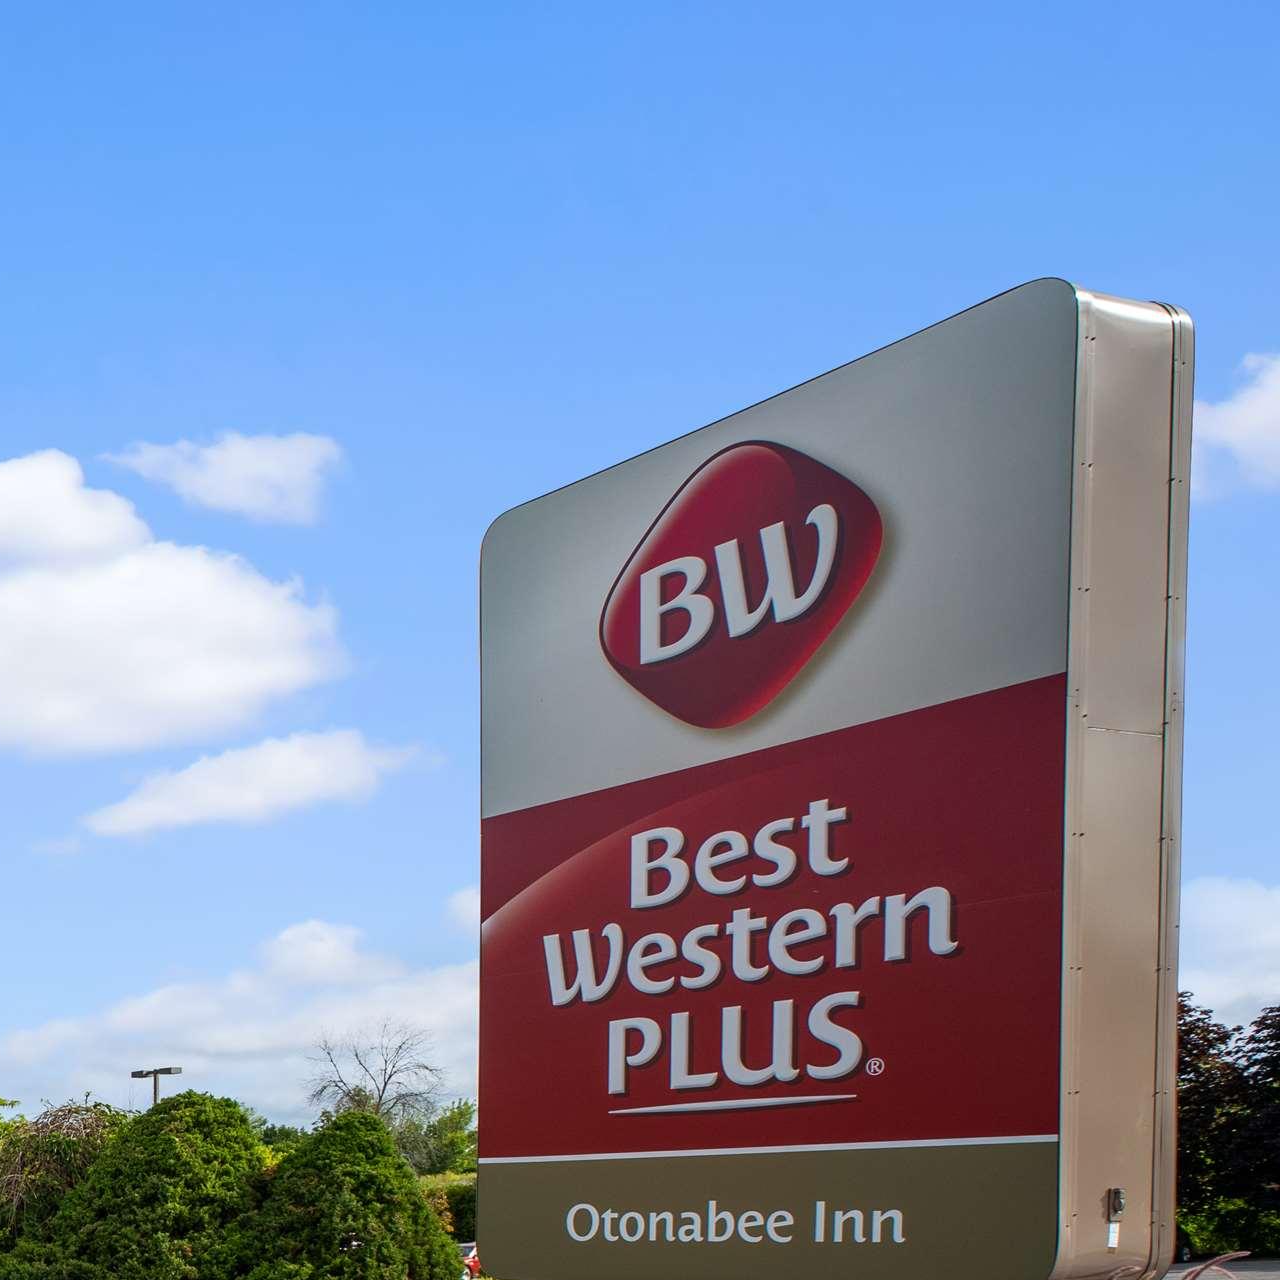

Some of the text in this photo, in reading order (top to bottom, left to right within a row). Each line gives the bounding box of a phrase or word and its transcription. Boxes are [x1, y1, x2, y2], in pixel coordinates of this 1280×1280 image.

[639, 502, 839, 666] BW
[629, 797, 851, 910] Best
[542, 885, 960, 1007] Western
[565, 1199, 907, 1244] Otonabee Inn
